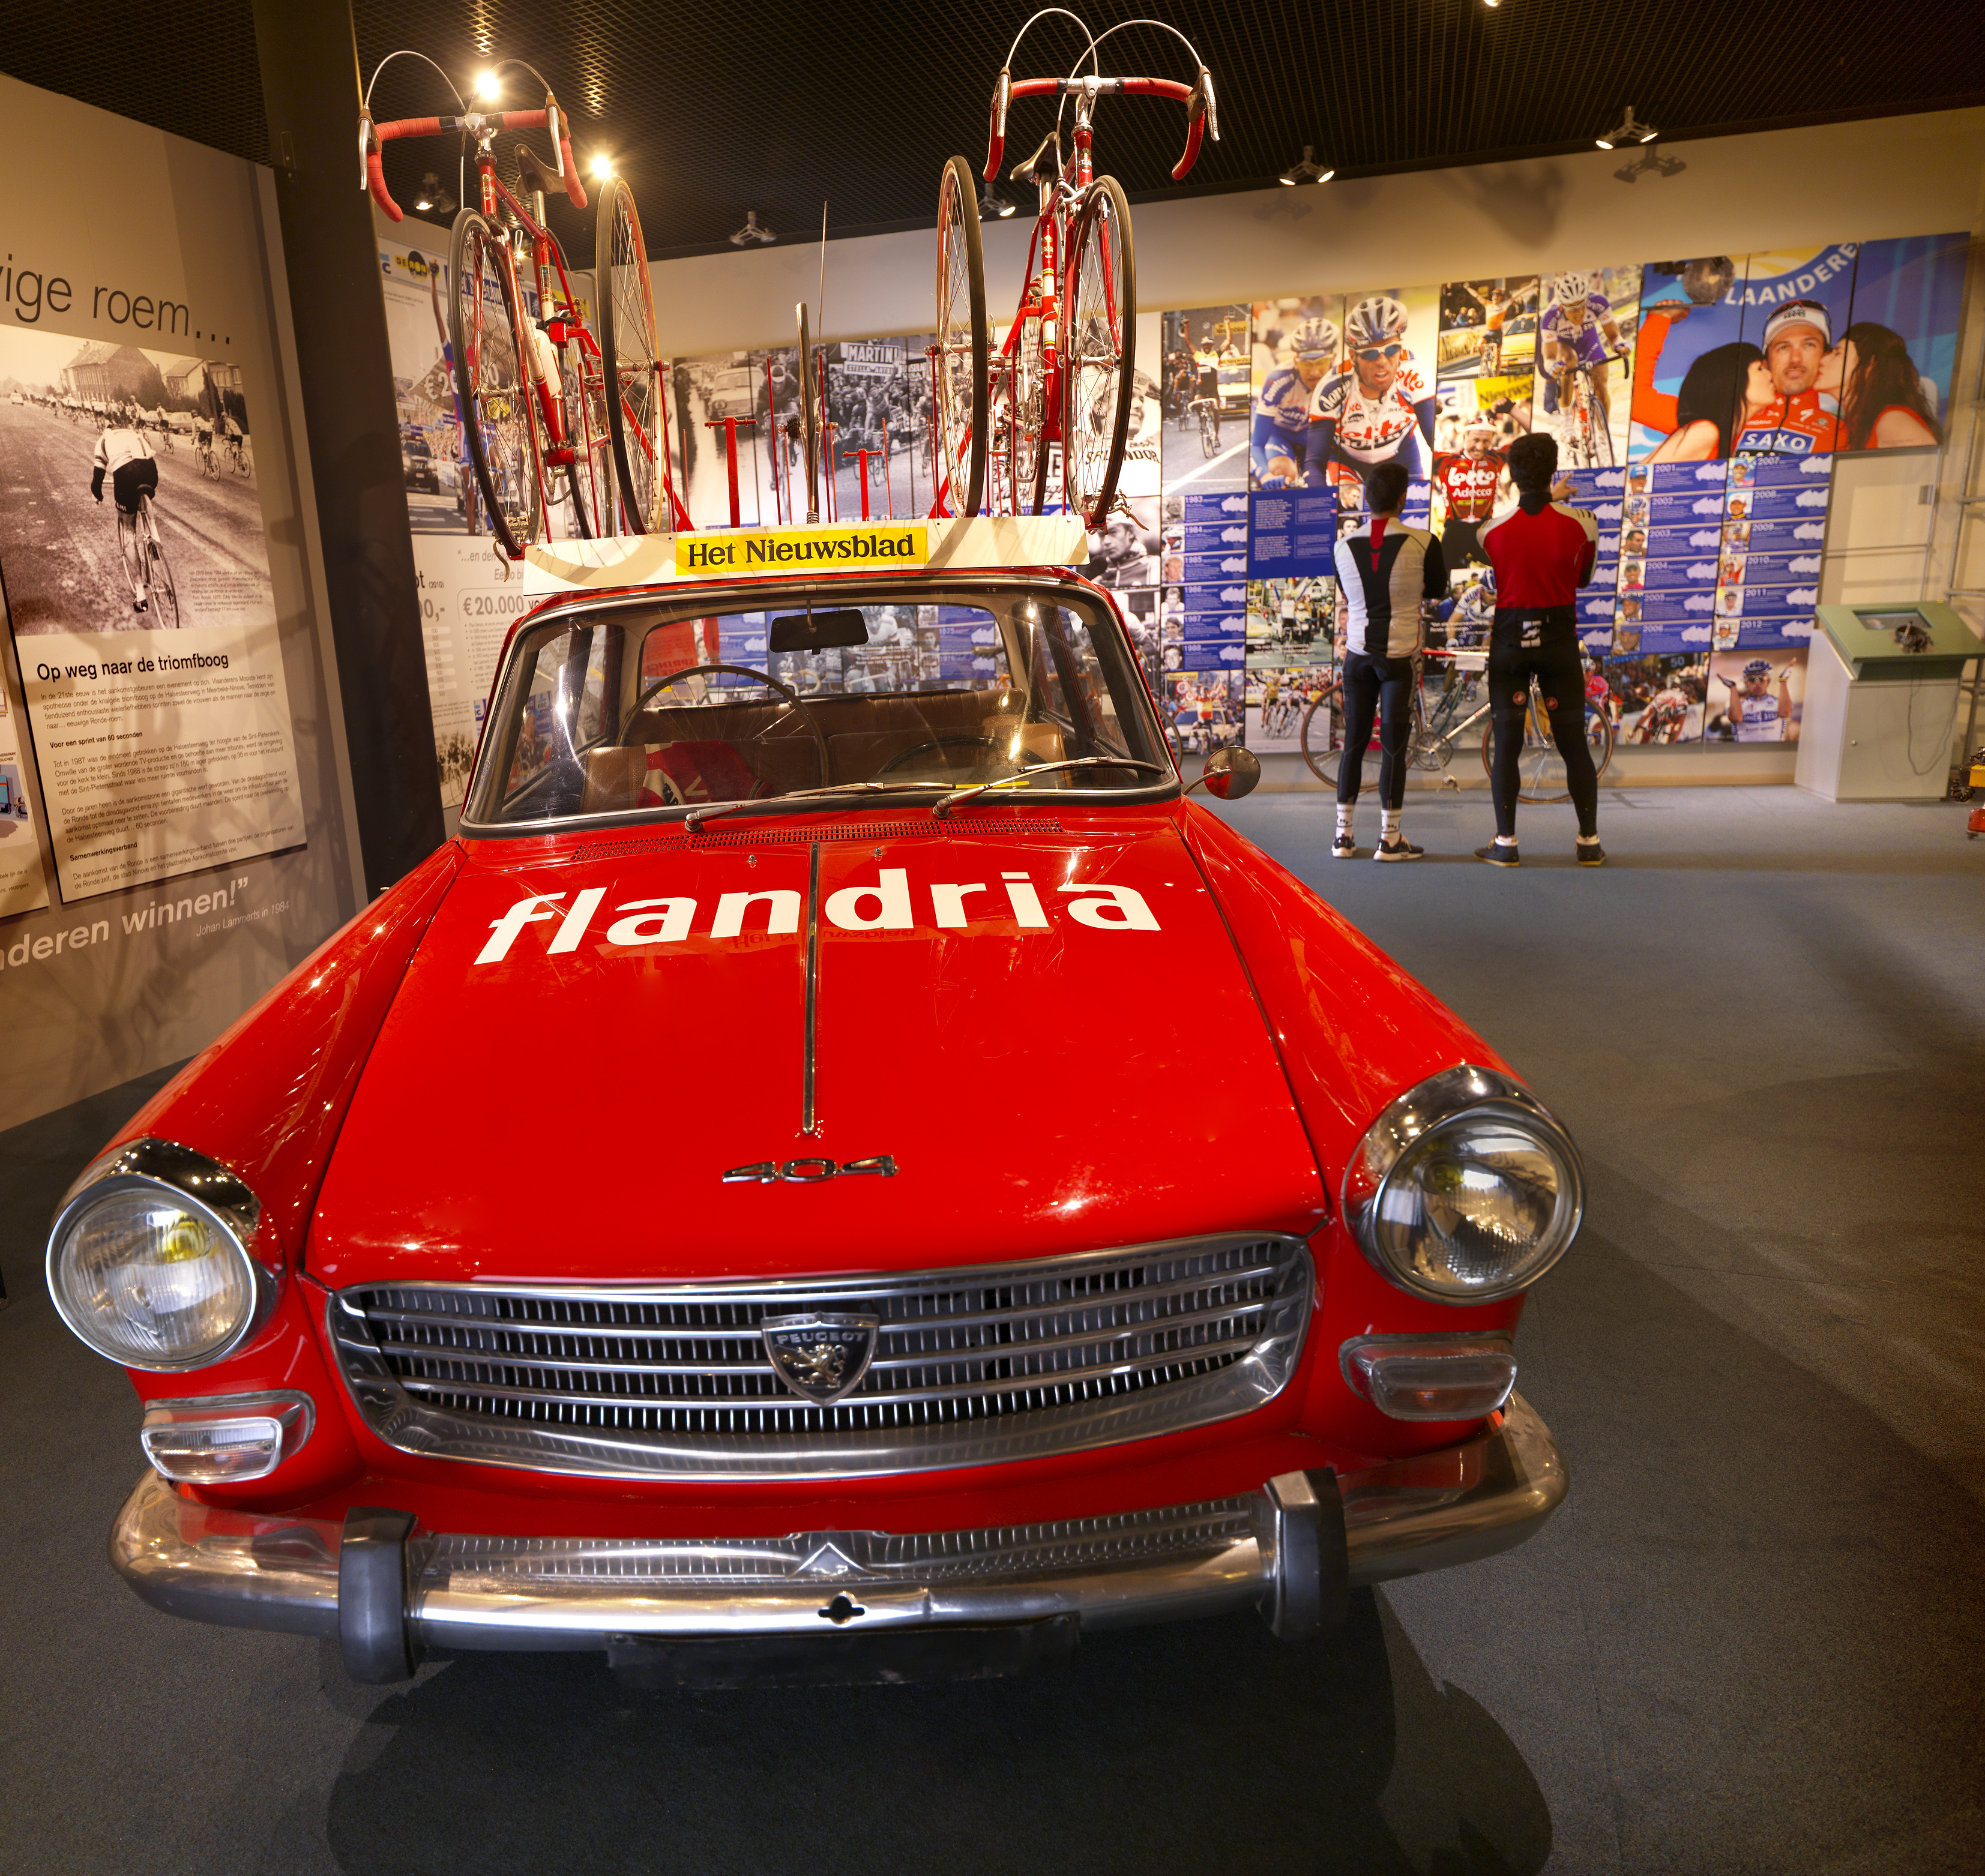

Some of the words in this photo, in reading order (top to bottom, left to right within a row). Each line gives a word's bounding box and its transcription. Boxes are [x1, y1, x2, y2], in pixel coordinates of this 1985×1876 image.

[1724, 241, 1858, 305] LAANDERE
[0, 253, 72, 323] ige
[849, 346, 899, 363] MARTINI
[1396, 369, 1424, 392] otto
[1744, 433, 1806, 451] SAXO
[1085, 449, 1161, 465] SPLNDOR
[1758, 457, 1780, 466] 2007
[1448, 467, 1495, 486] lotto
[1452, 487, 1492, 498] Adecco
[1755, 490, 1777, 499] 2008
[1652, 497, 1673, 505] 2002
[1649, 529, 1670, 538] 2003
[1752, 523, 1774, 531] 2009
[688, 543, 735, 567] Het
[746, 534, 915, 563] Nieuwsblad
[1646, 562, 1667, 570] 2004
[1747, 556, 1770, 565] 2010
[429, 580, 444, 589] (2010)
[1745, 589, 1767, 597] 2011
[1740, 620, 1762, 628] 2012
[37, 663, 60, 682] Op
[65, 664, 97, 680] weg
[102, 660, 132, 675] naar
[137, 657, 154, 673] de
[158, 652, 229, 671] triomfboog
[1670, 656, 1685, 668] 50
[107, 684, 155, 695] aankomstgebeuren
[42, 700, 72, 711] apotheose
[98, 696, 121, 705] knalgele
[121, 693, 148, 703] triomfboog
[164, 688, 200, 699] Halsesteenweg
[44, 710, 76, 719] tienduizend
[76, 706, 110, 715] enthousiaste
[109, 702, 151, 712] wielerliefhebbers
[152, 700, 172, 709] sprinten
[65, 718, 89, 728] eeuwige
[89, 714, 123, 724] Ronde-roem.
[77, 736, 95, 746] sprint
[115, 730, 143, 739] seconden
[107, 750, 131, 759] eindmeet
[132, 747, 157, 757] getrokken
[78, 779, 123, 792] Sint-Pietersstraat
[69, 841, 137, 862] Samenwerkingsverband
[196, 922, 220, 937] Johan
[222, 910, 260, 930] Lammerts
[261, 906, 268, 916] in
[270, 900, 289, 915] 1984
[474, 868, 1161, 964] flandria
[722, 1154, 900, 1184] 404
[776, 1332, 866, 1344] PEUGEOT
